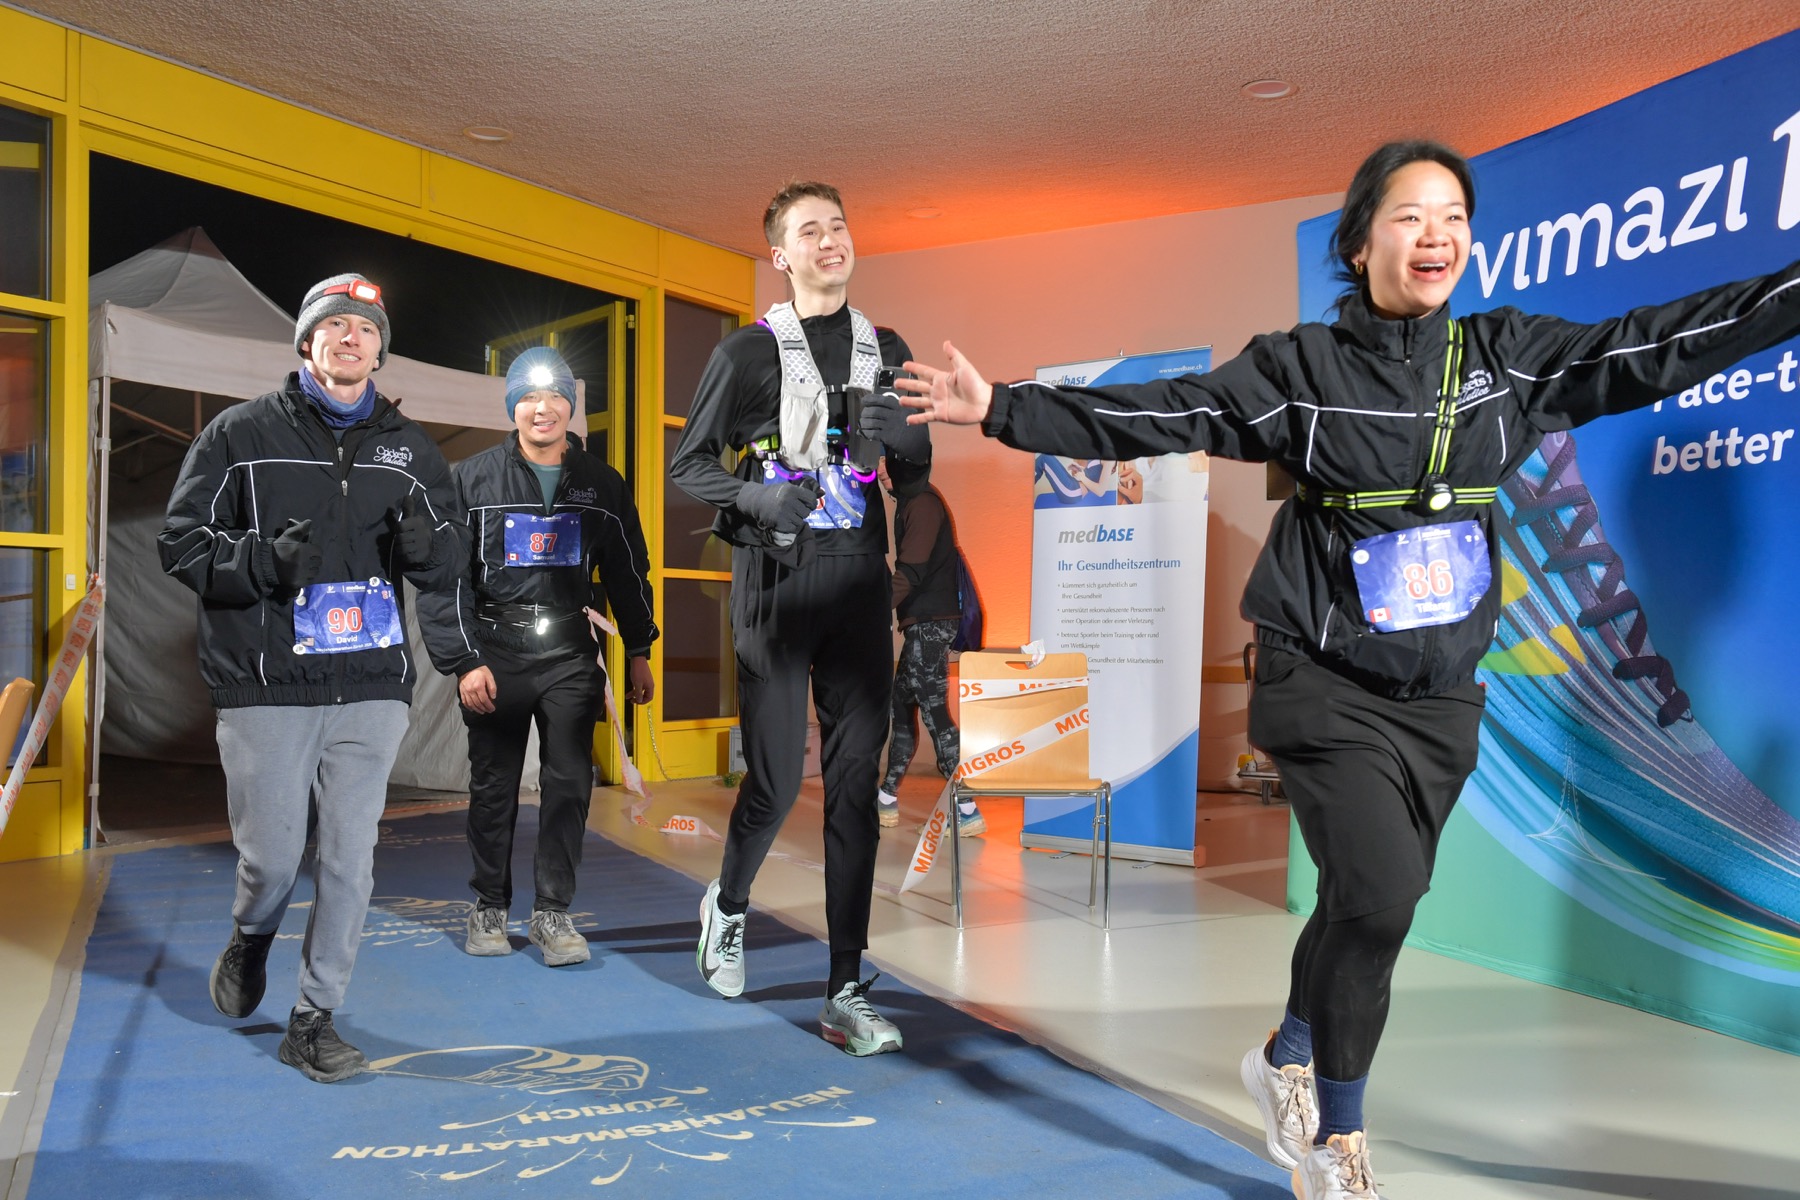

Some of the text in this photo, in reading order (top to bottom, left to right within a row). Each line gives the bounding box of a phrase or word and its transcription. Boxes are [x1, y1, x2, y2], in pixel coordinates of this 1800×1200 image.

[1158, 364, 1203, 374] www.medbase.ch
[1653, 350, 1800, 413] ace-t
[1653, 427, 1795, 475] better
[530, 532, 557, 553] 87
[1058, 558, 1181, 571] Ihr Gesundheitszentrum
[1403, 559, 1454, 600] 86
[327, 606, 363, 634] 90
[1075, 617, 1101, 625] Operation
[336, 635, 358, 644] David
[1055, 708, 1089, 735] MIG
[952, 740, 1026, 781] MIGROS
[914, 807, 945, 873] MIGROS
[331, 1085, 854, 1159] NEUJAHRSMARATHON
[518, 1096, 683, 1125] ZÜRICH
